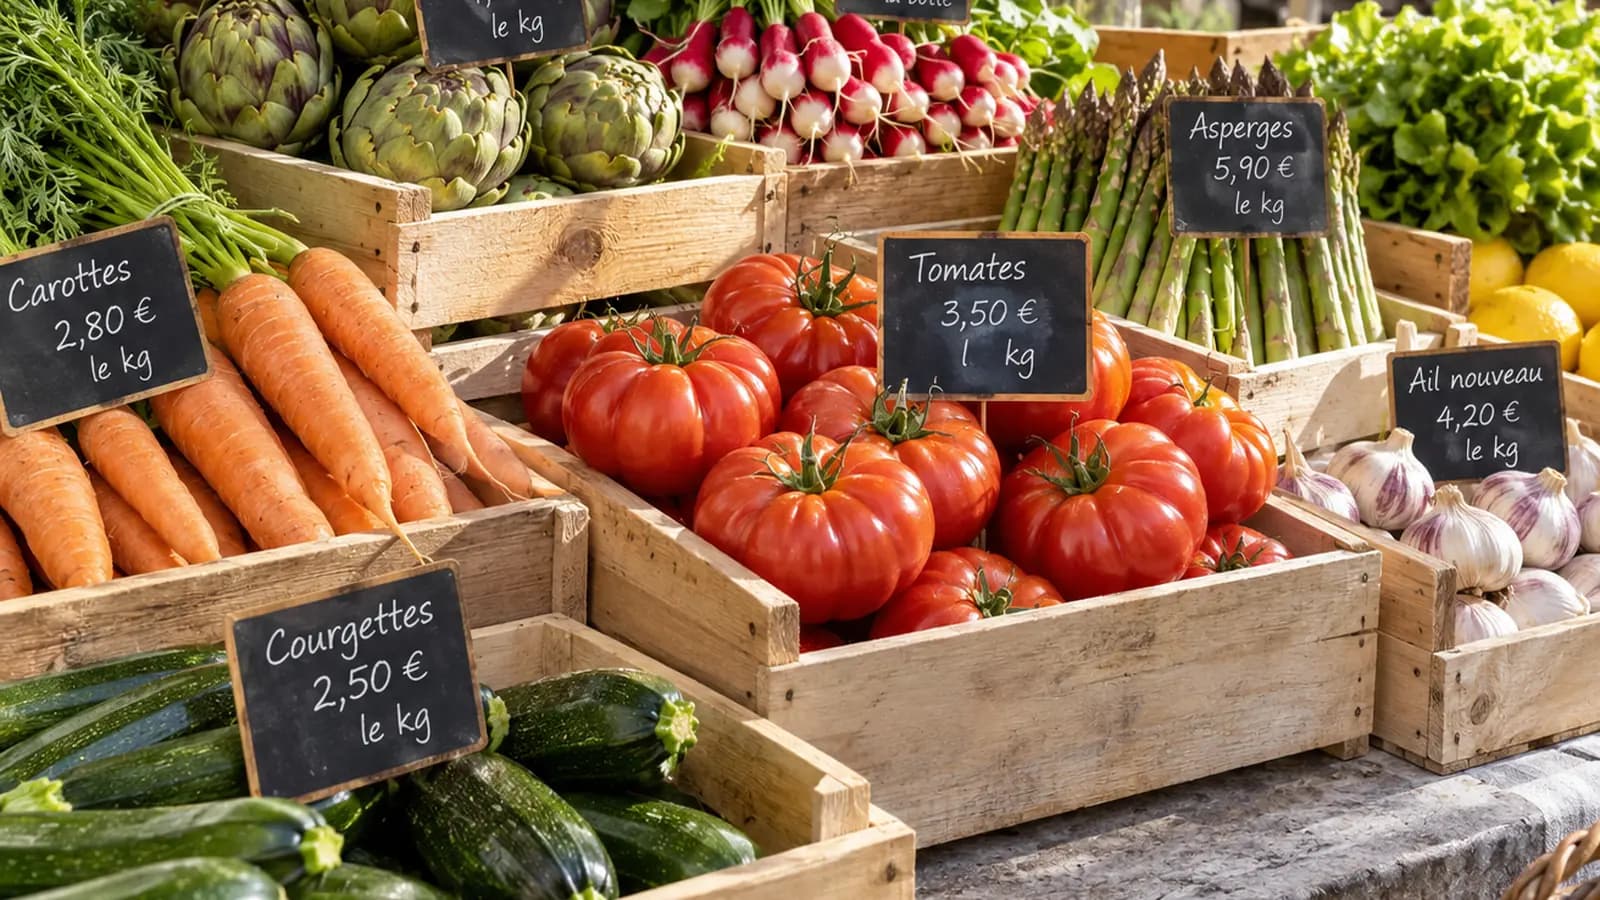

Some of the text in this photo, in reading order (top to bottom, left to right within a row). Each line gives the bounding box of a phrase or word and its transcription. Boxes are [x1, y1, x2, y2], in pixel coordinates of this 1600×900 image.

[491, 8, 545, 44] le kg
[1188, 111, 1294, 151] Asperges
[1213, 155, 1295, 186] 5,90 €
[1234, 190, 1285, 225] le kg
[7, 257, 133, 312] Carottes
[908, 251, 1027, 283] Tomates
[54, 296, 158, 352] 2,80 €
[940, 298, 1039, 333] 3,50 €
[90, 345, 153, 383] le kg
[1004, 338, 1036, 380] kg
[1408, 365, 1544, 394] Ail nouveau
[1436, 400, 1521, 434] 4,20 €
[1465, 435, 1519, 468] le kg
[265, 599, 435, 666] Courgettes
[313, 650, 429, 713] 2,50 €
[359, 703, 431, 745] le kg
